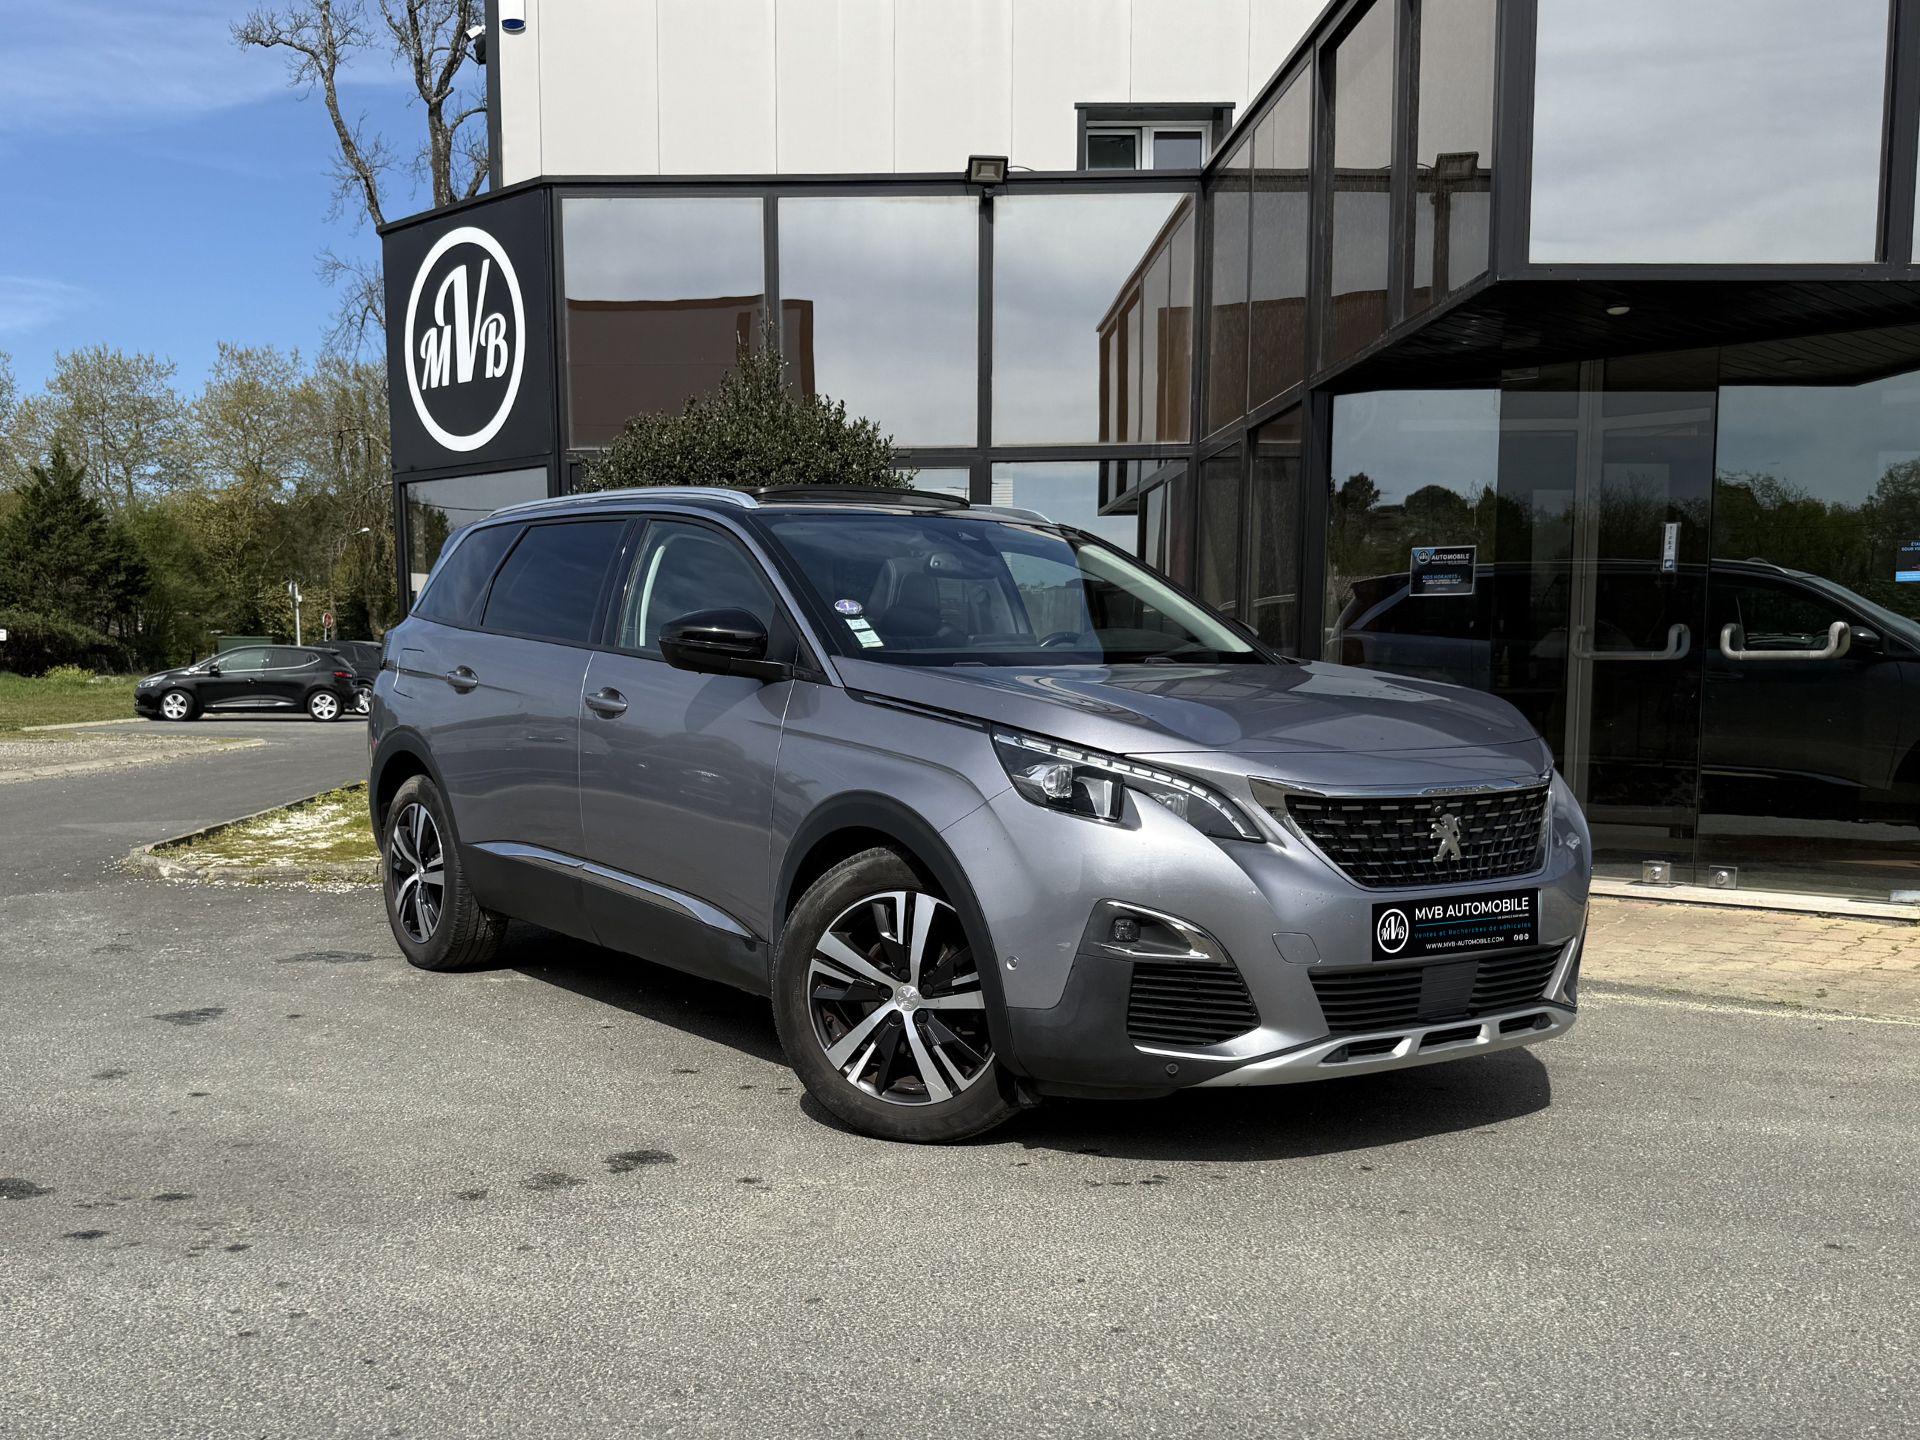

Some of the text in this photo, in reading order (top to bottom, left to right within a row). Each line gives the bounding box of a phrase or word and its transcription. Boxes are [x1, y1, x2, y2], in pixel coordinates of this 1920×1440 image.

[420, 259, 509, 390] MVB
[1415, 897, 1529, 921] MVB AUTOMOBILE
[1381, 915, 1405, 940] MVB
[1414, 929, 1437, 938] Ventes
[1426, 936, 1505, 949] WWW.MVB-AUTOMOBILE.COM
